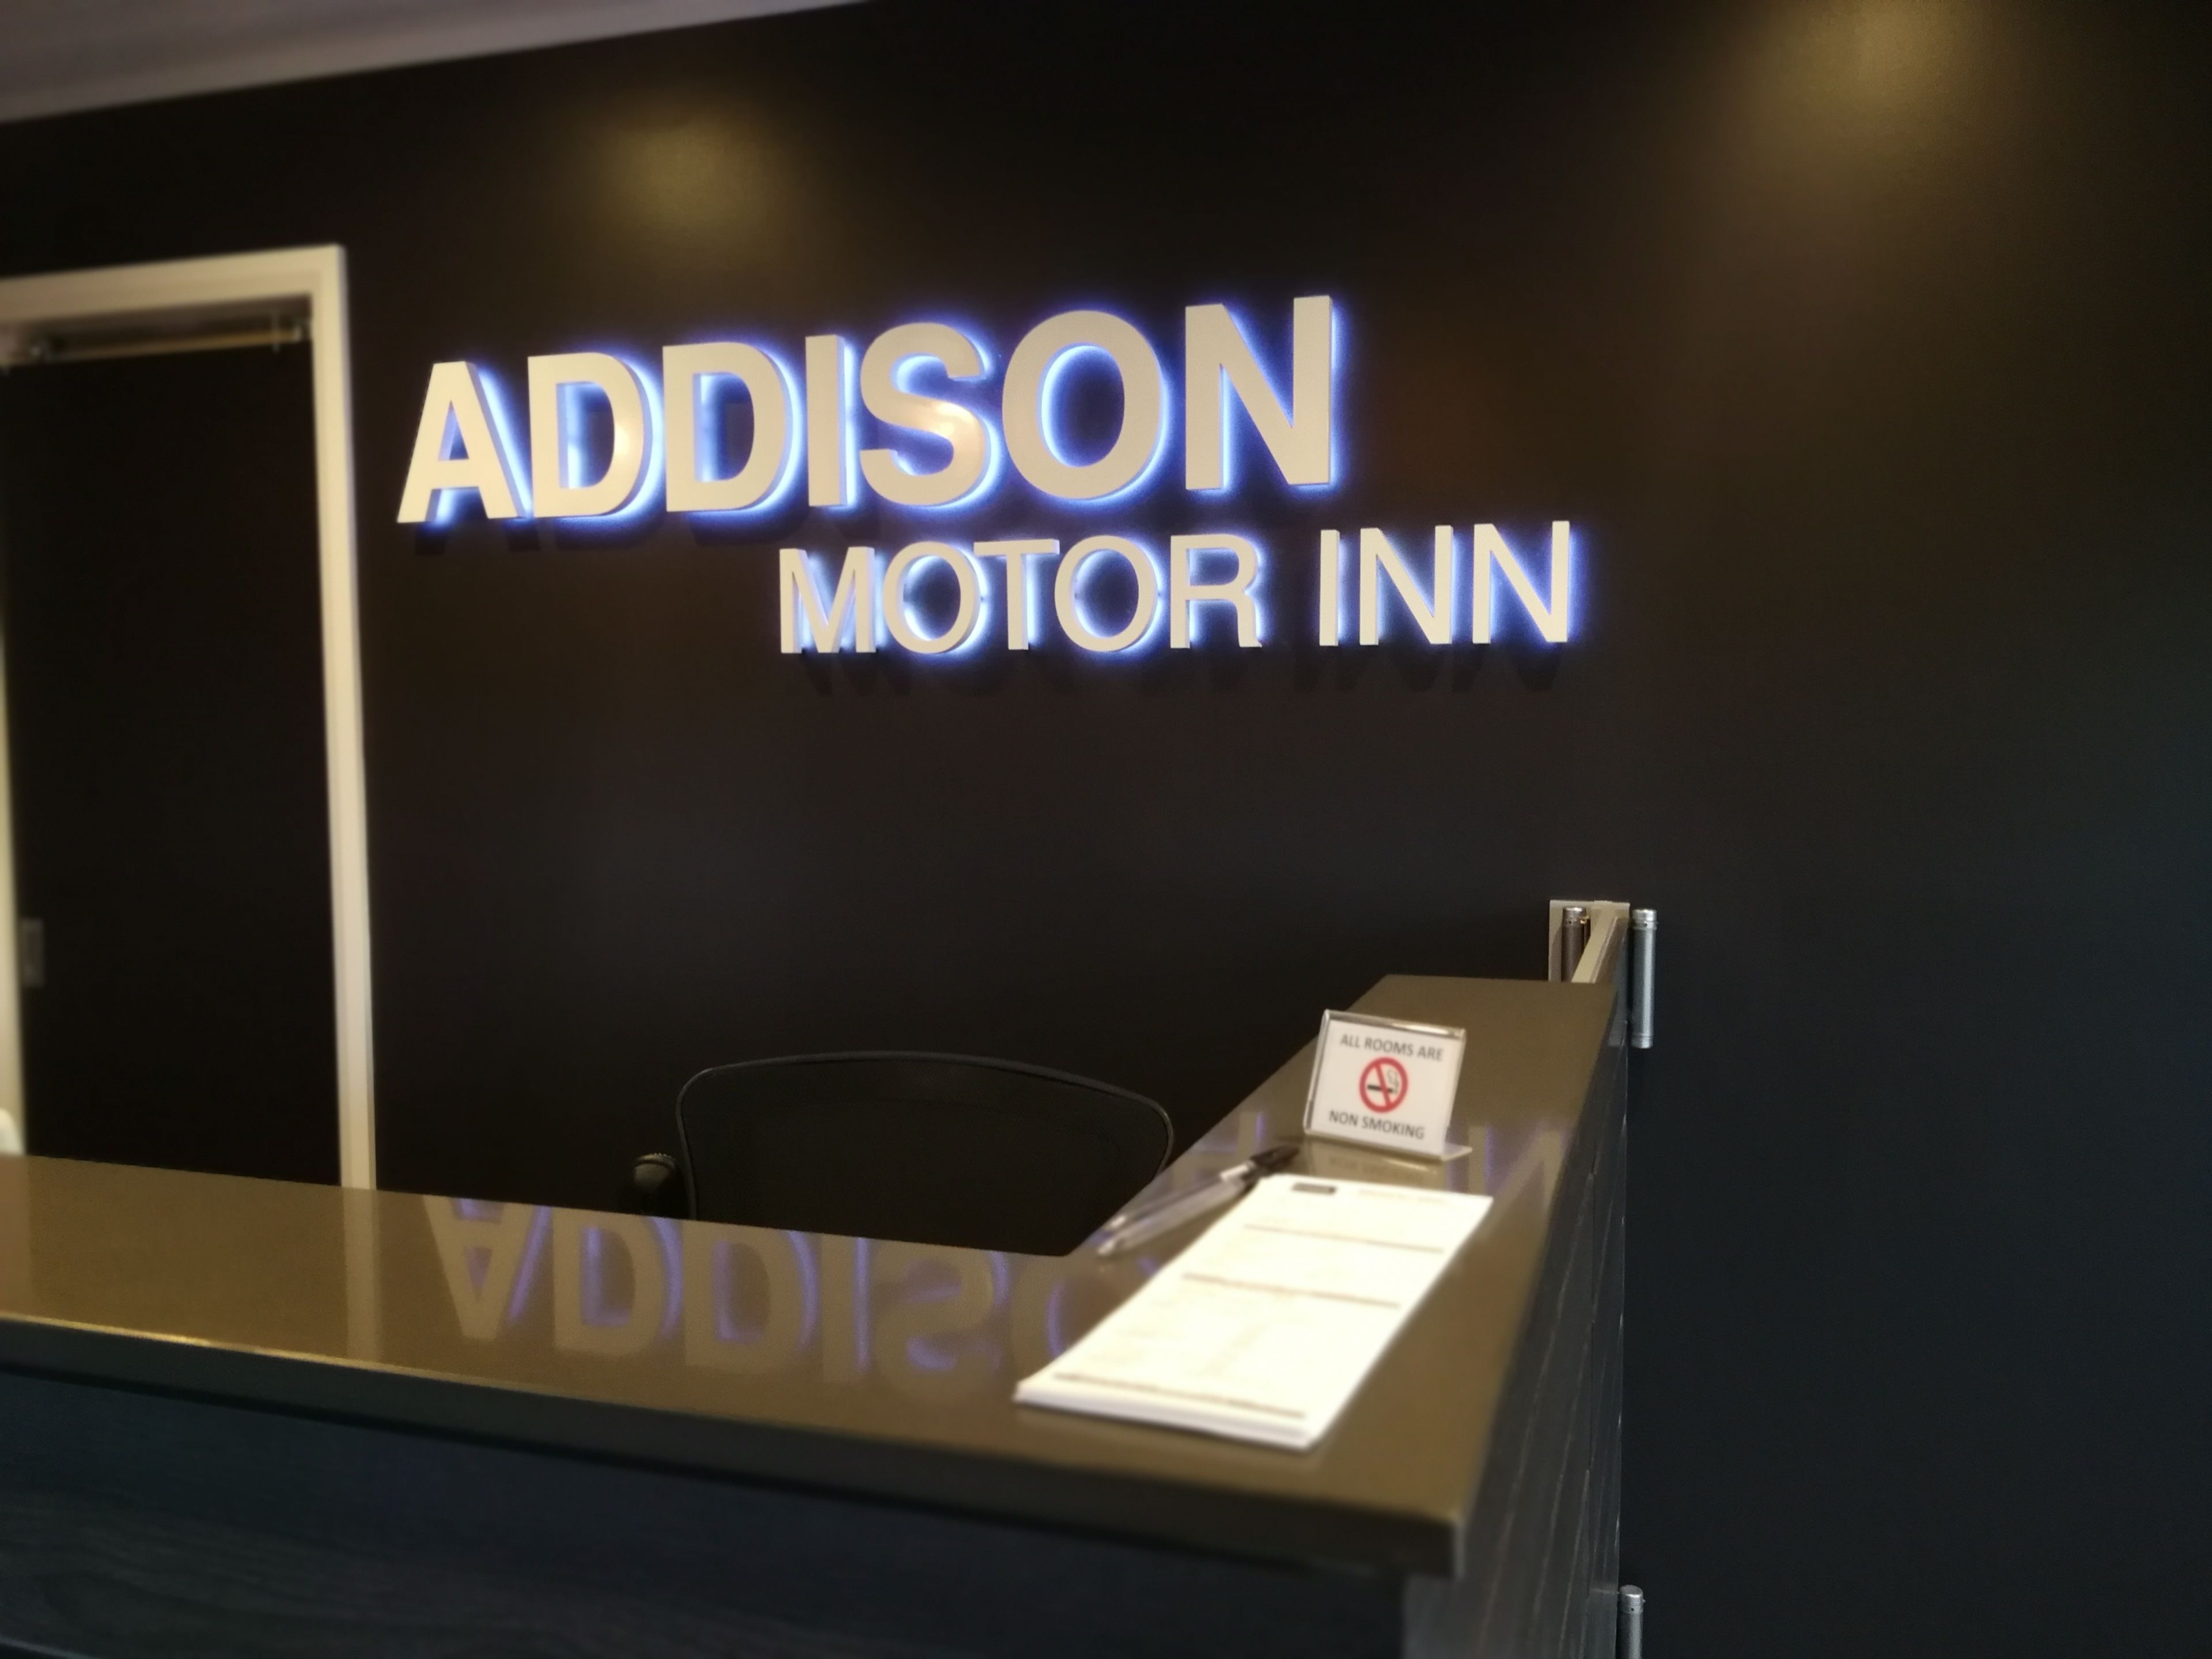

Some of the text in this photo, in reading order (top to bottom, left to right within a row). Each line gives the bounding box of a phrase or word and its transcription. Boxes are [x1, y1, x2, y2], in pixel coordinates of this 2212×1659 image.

[397, 295, 1333, 523] ADDISON
[779, 520, 1570, 654] MOTOR INN
[1340, 1034, 1444, 1062] ALL ROOMS ARE
[1328, 1110, 1425, 1140] NON SMOKING
